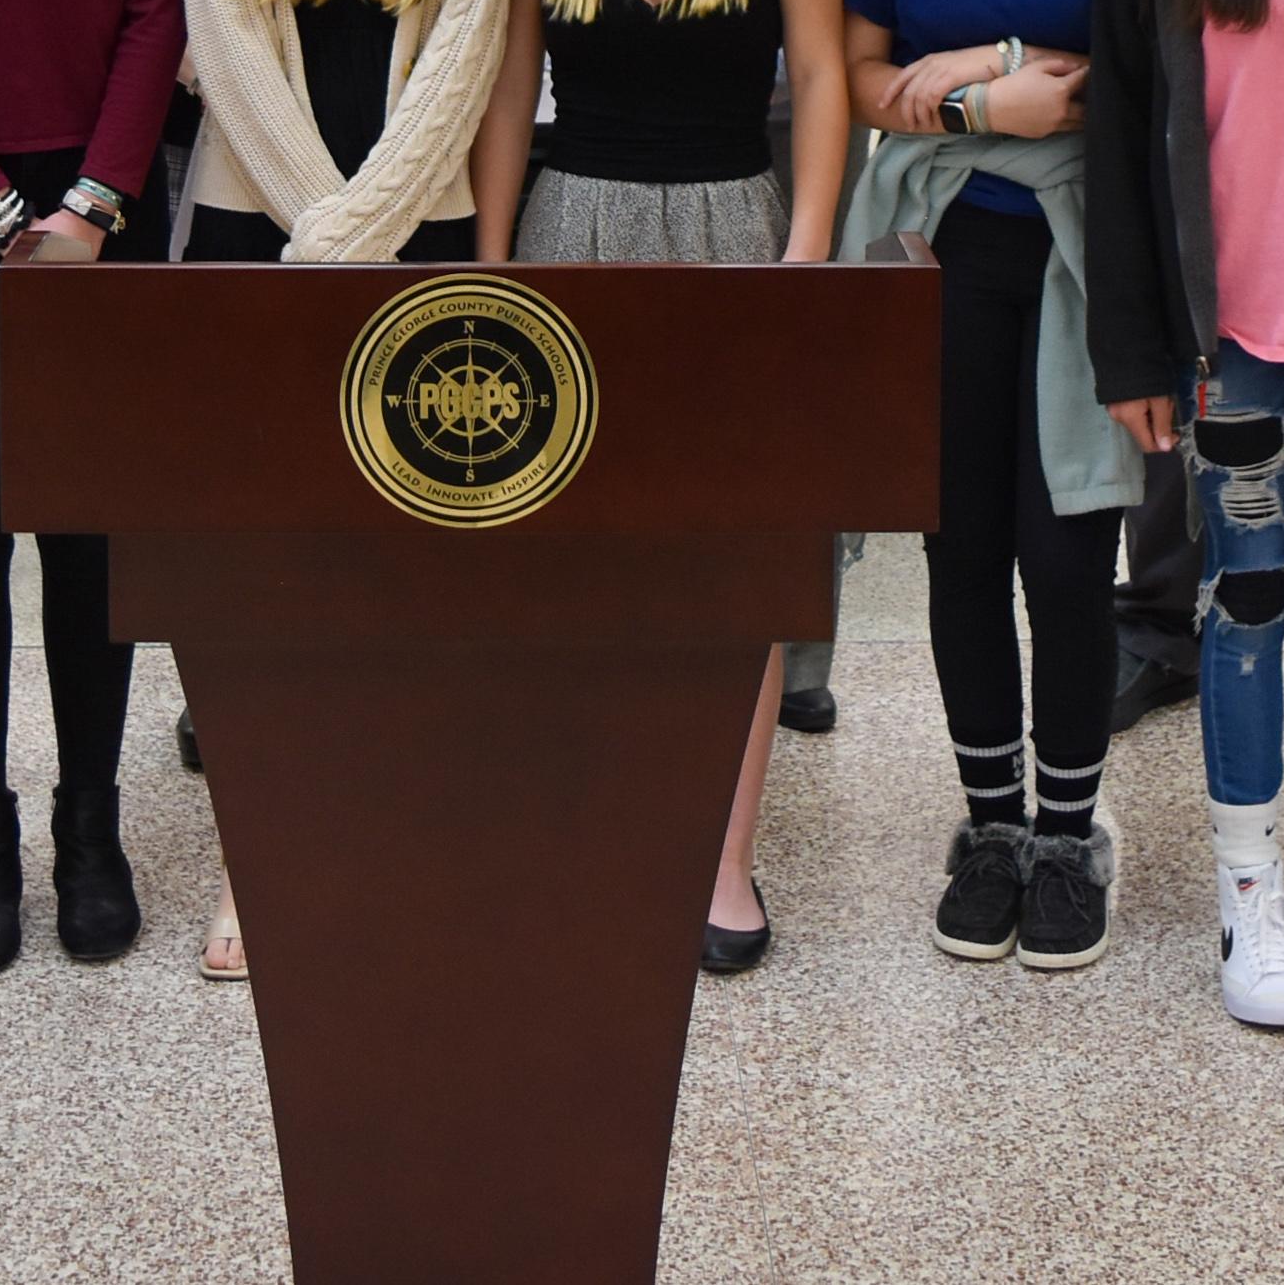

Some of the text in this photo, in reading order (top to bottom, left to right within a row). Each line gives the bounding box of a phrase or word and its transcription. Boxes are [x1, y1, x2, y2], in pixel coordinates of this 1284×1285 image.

[463, 320, 475, 334] N
[369, 301, 569, 387] PRINCE GEORGE COUNTY PUBLIC SCHOOLS
[385, 394, 403, 408] W
[419, 381, 521, 420] PGCPS
[540, 394, 551, 408] E
[391, 460, 421, 490] LEAD.
[426, 483, 498, 503] INNOVATE.
[465, 469, 475, 483] S
